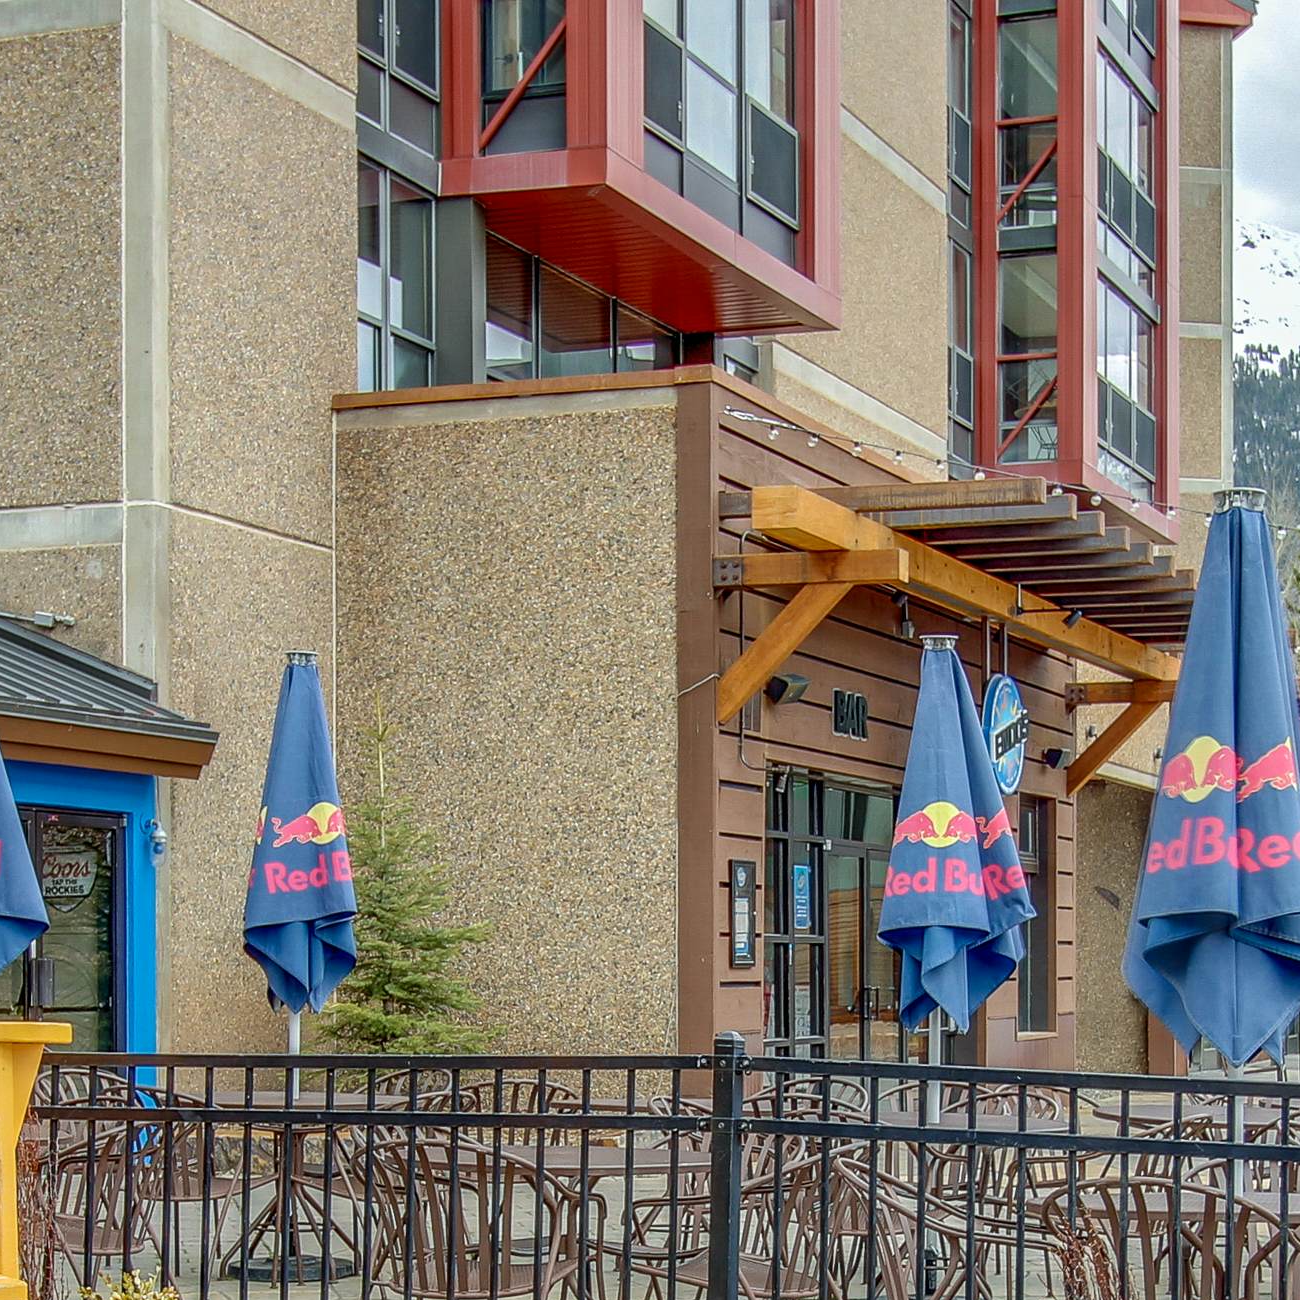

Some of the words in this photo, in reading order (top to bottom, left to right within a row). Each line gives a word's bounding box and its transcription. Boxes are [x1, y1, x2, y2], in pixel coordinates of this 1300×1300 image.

[832, 687, 868, 741] BAR
[42, 853, 91, 879] Coors
[264, 853, 329, 895] Red
[45, 885, 85, 896] ROCKIES
